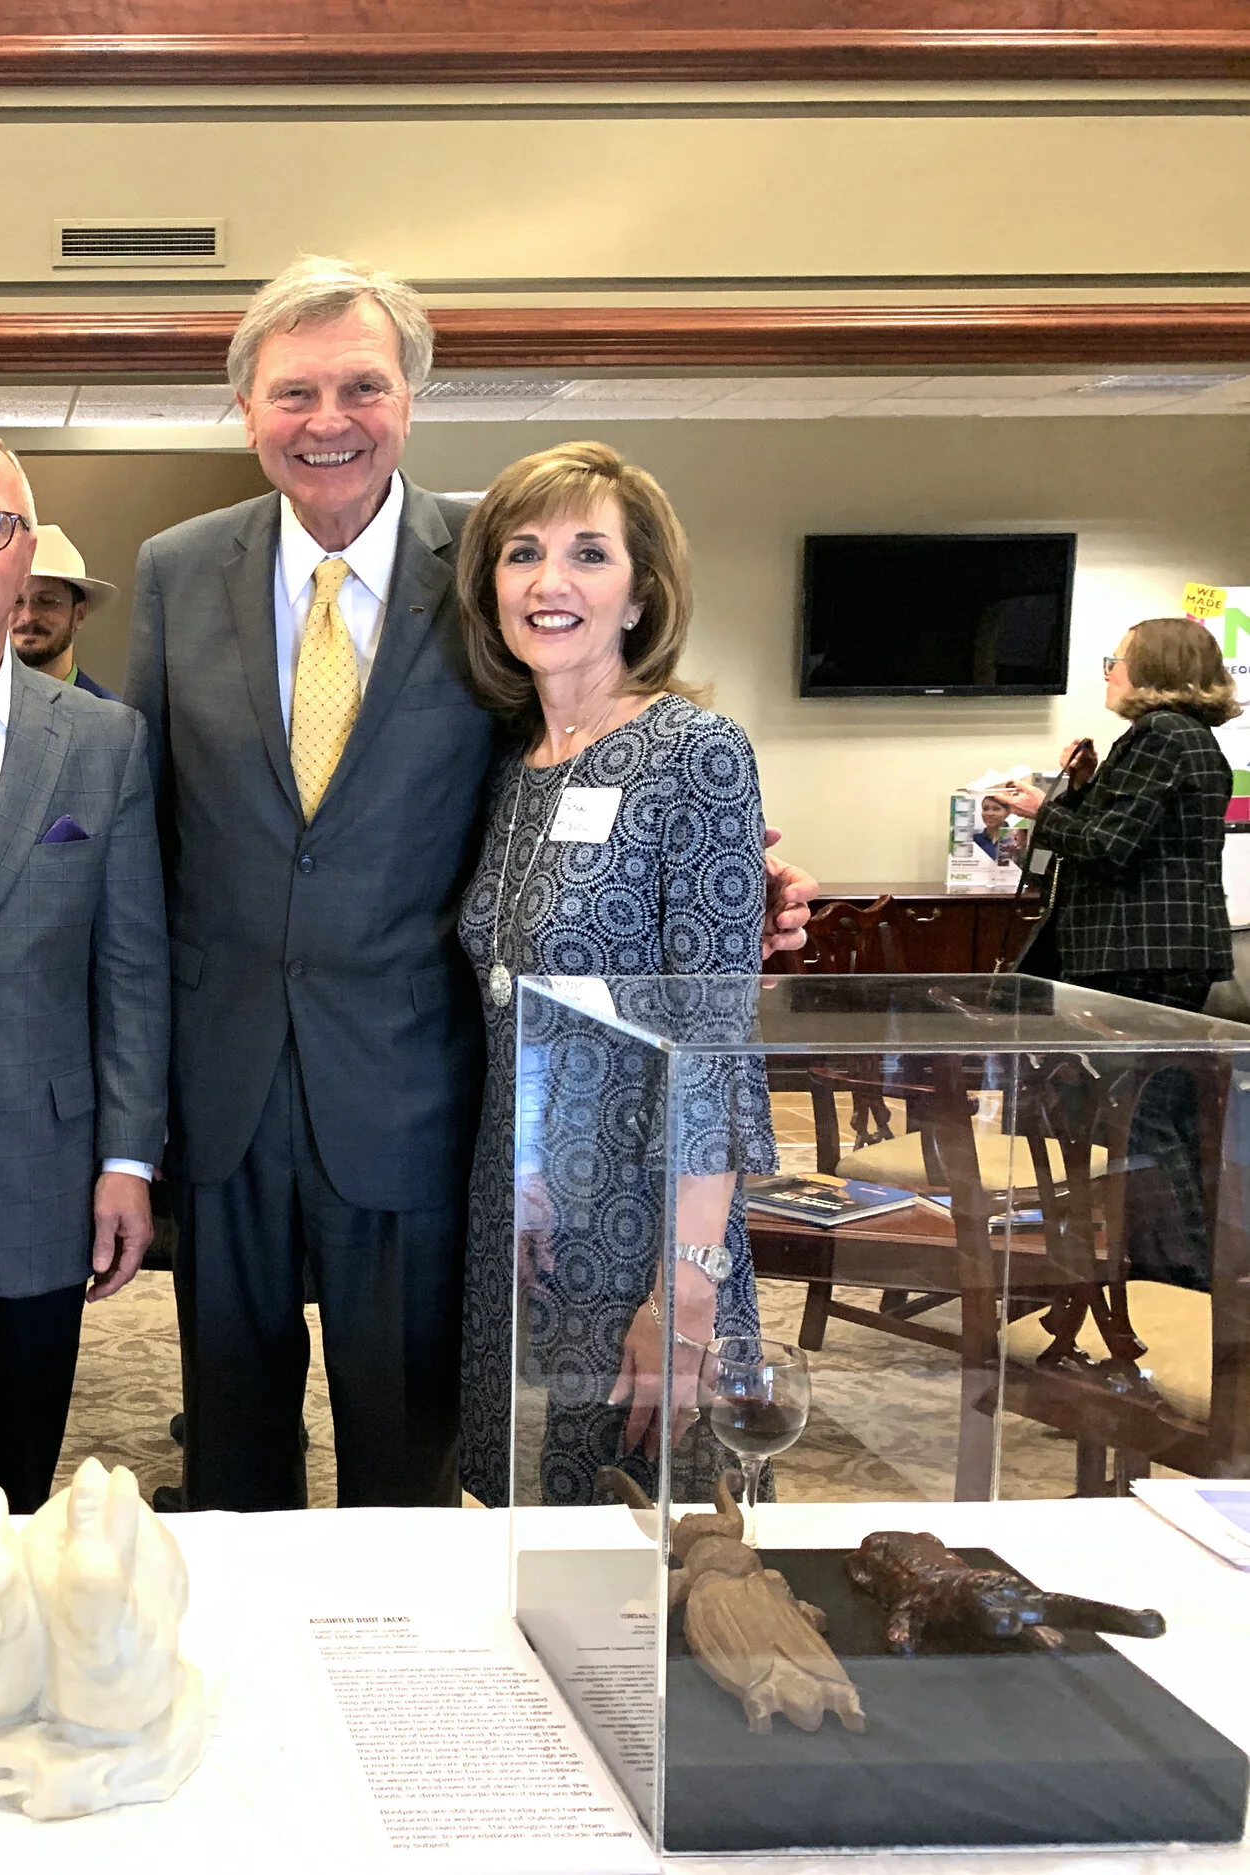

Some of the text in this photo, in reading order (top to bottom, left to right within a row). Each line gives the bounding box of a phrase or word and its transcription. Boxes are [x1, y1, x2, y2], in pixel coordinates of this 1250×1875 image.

[1197, 587, 1216, 598] WE
[1186, 595, 1222, 609] MADE
[413, 1842, 451, 1850] subject
